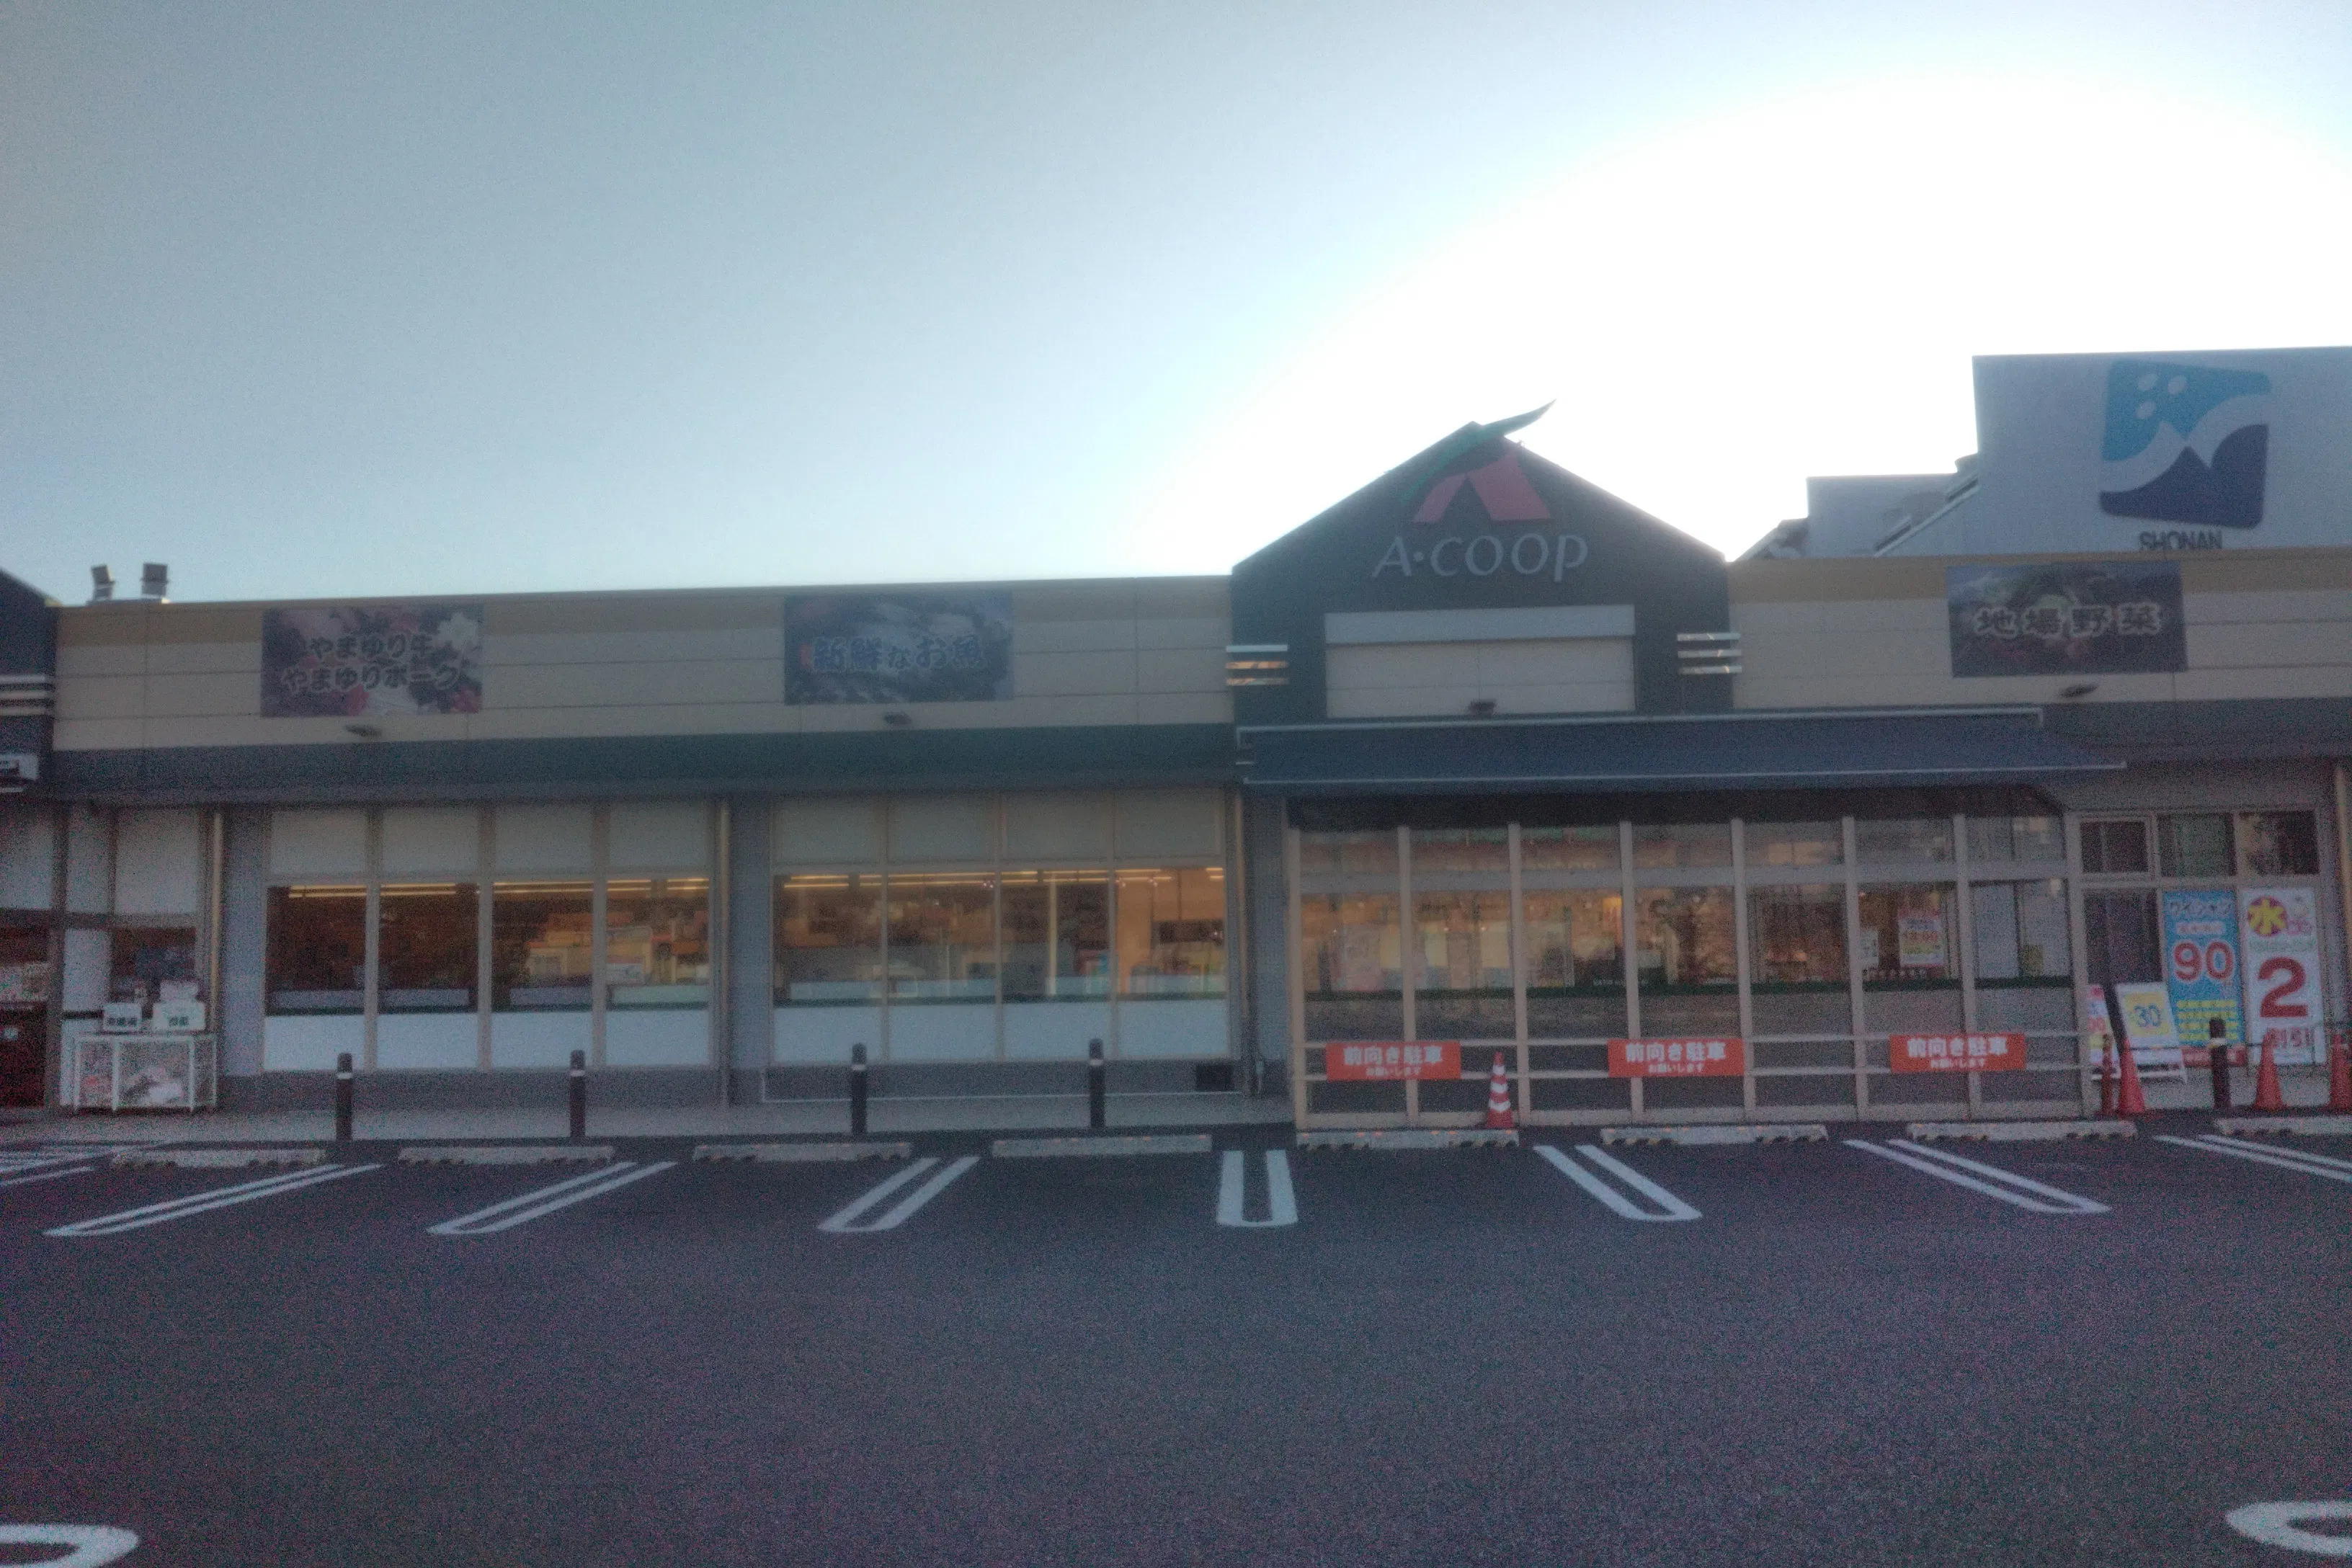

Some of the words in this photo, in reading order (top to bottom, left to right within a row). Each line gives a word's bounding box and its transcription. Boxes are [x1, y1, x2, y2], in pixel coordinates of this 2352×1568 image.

[2139, 530, 2223, 551] SHONAN
[2173, 940, 2235, 981] 90
[2257, 956, 2308, 1017] 2
[2134, 1004, 2162, 1028] 30
[1625, 1041, 1727, 1063] 前向き駐車
[1906, 1036, 2009, 1058] 前向き駐車
